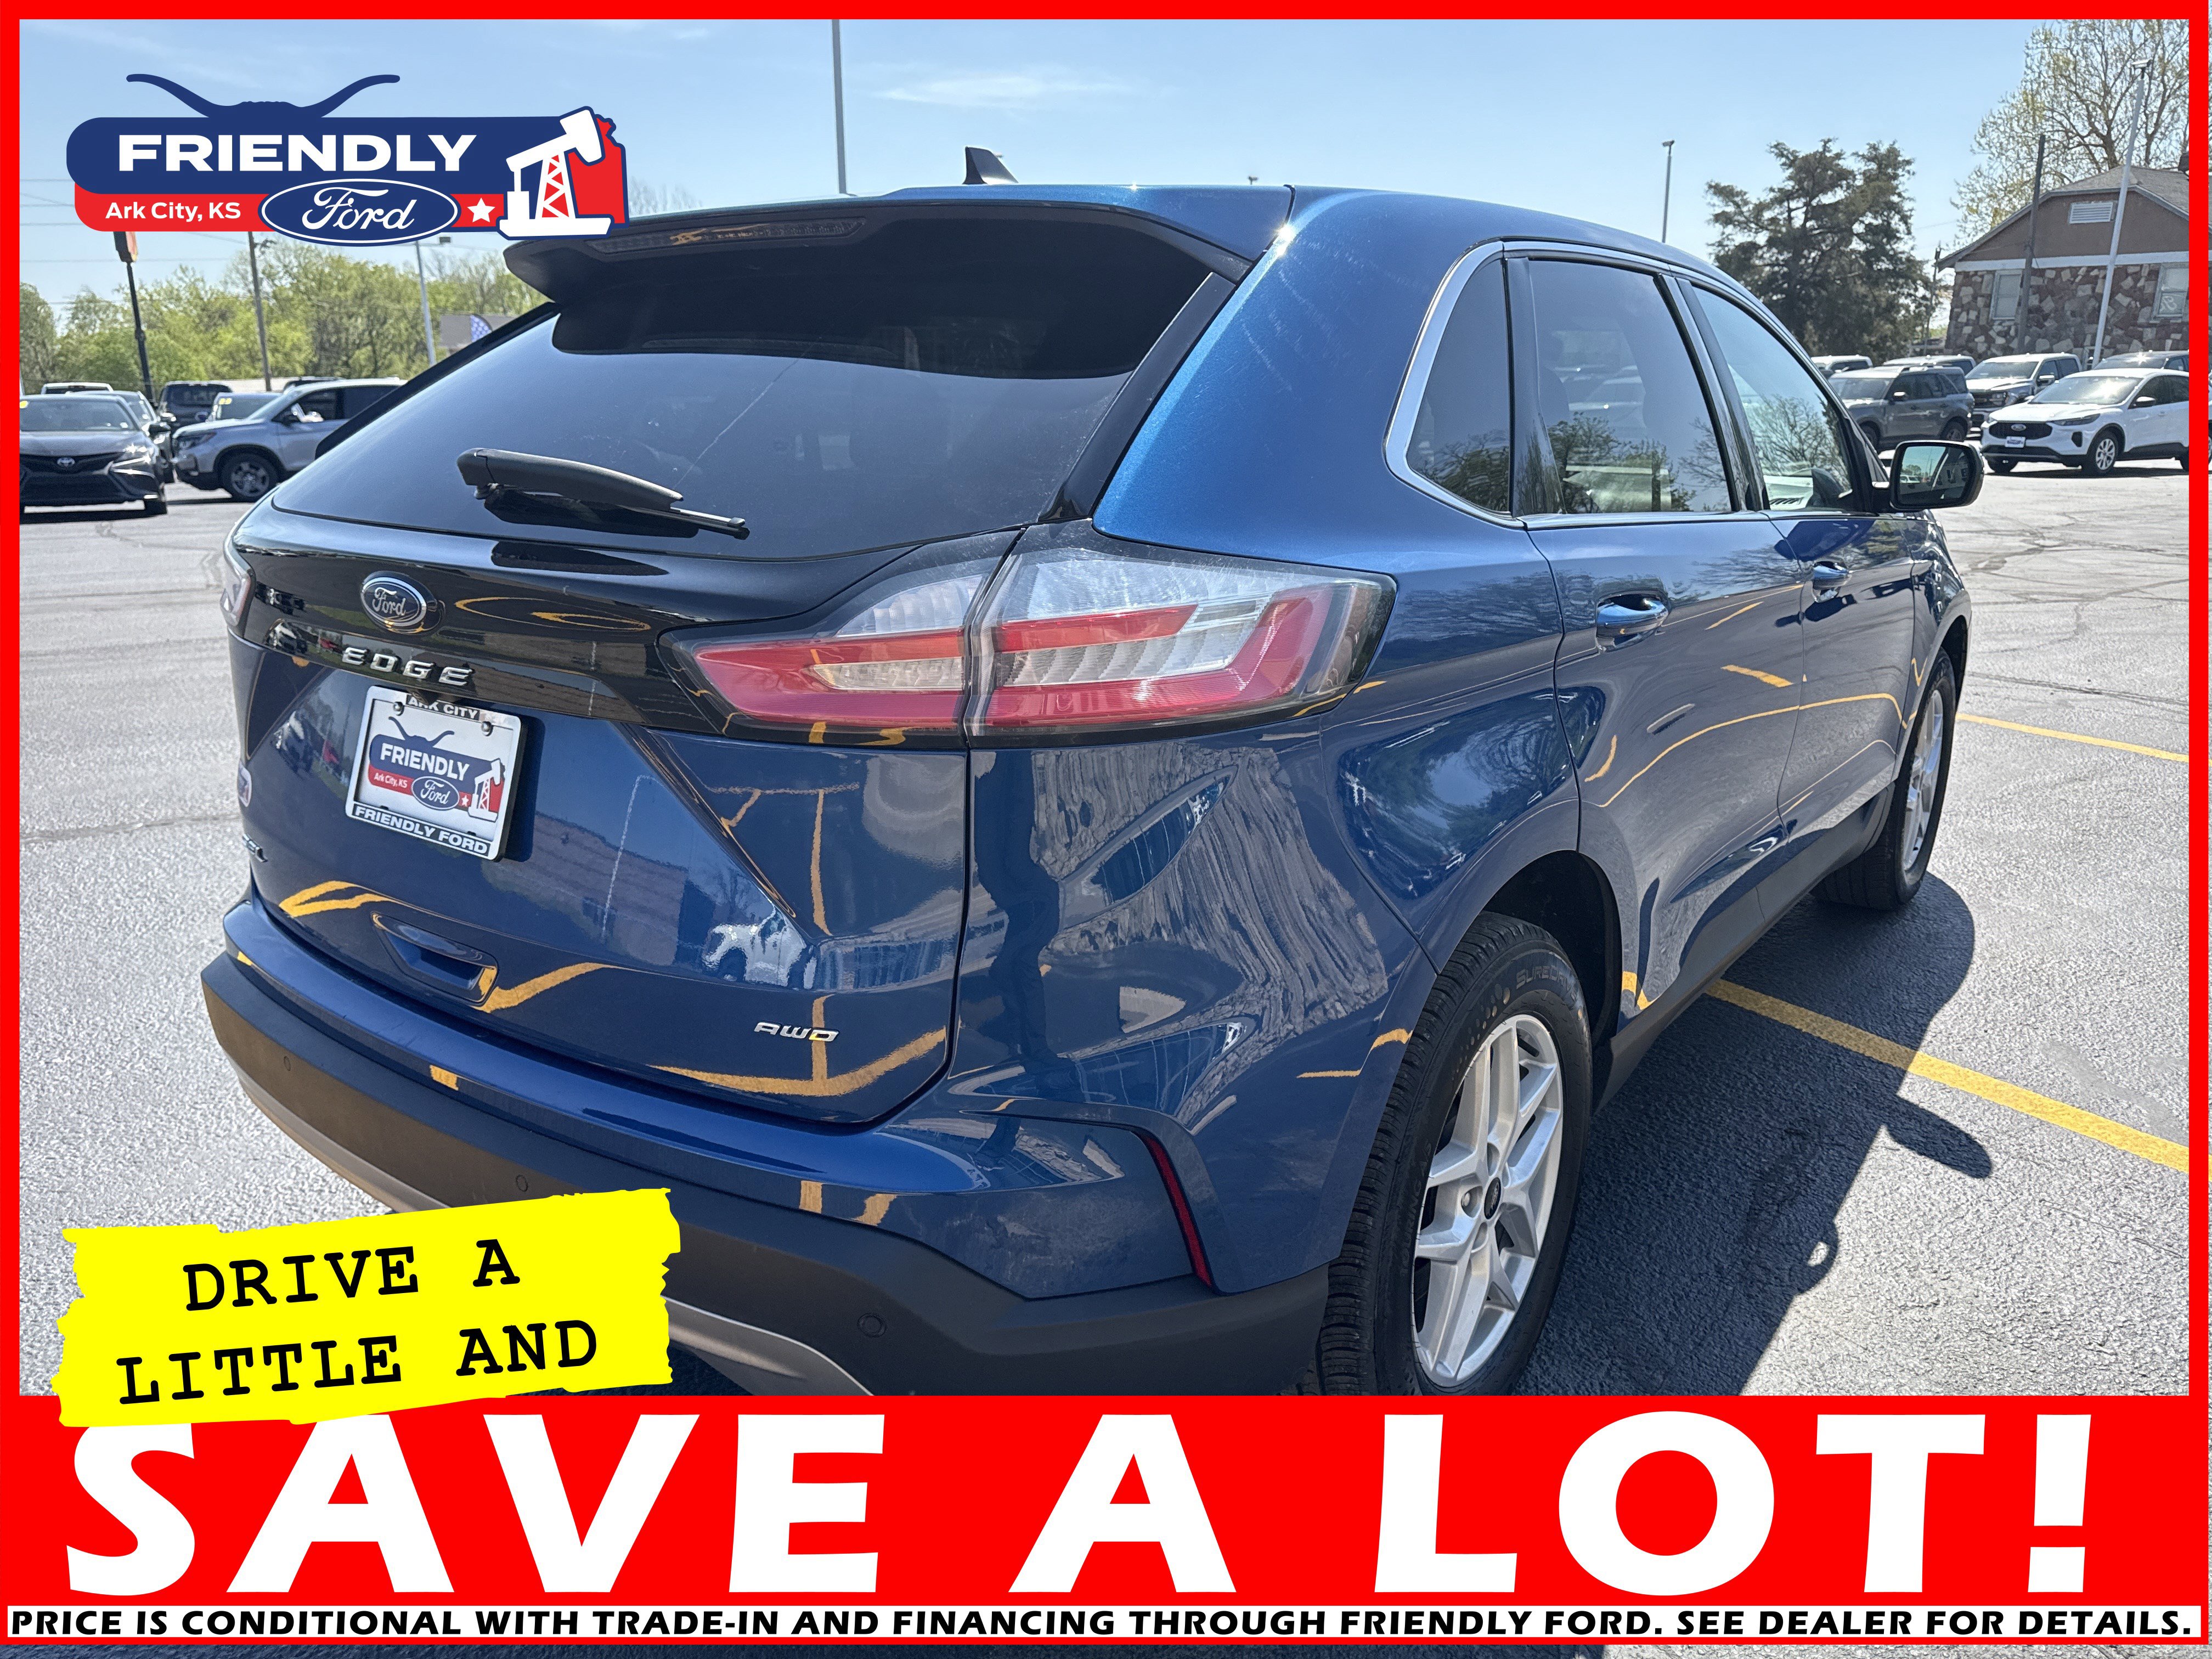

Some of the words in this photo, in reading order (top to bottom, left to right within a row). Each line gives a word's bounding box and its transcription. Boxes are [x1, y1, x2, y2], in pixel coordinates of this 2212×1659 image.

[372, 586, 407, 616] Ford
[342, 647, 473, 686] EDGE
[443, 704, 479, 719] CITY
[380, 742, 470, 781] FRIENDLY
[374, 772, 386, 781] Ark
[398, 777, 408, 788] KS
[420, 779, 449, 805] Ford
[355, 805, 436, 838] FRIENDLY
[438, 830, 488, 854] FORD
[754, 1022, 839, 1042] AWD
